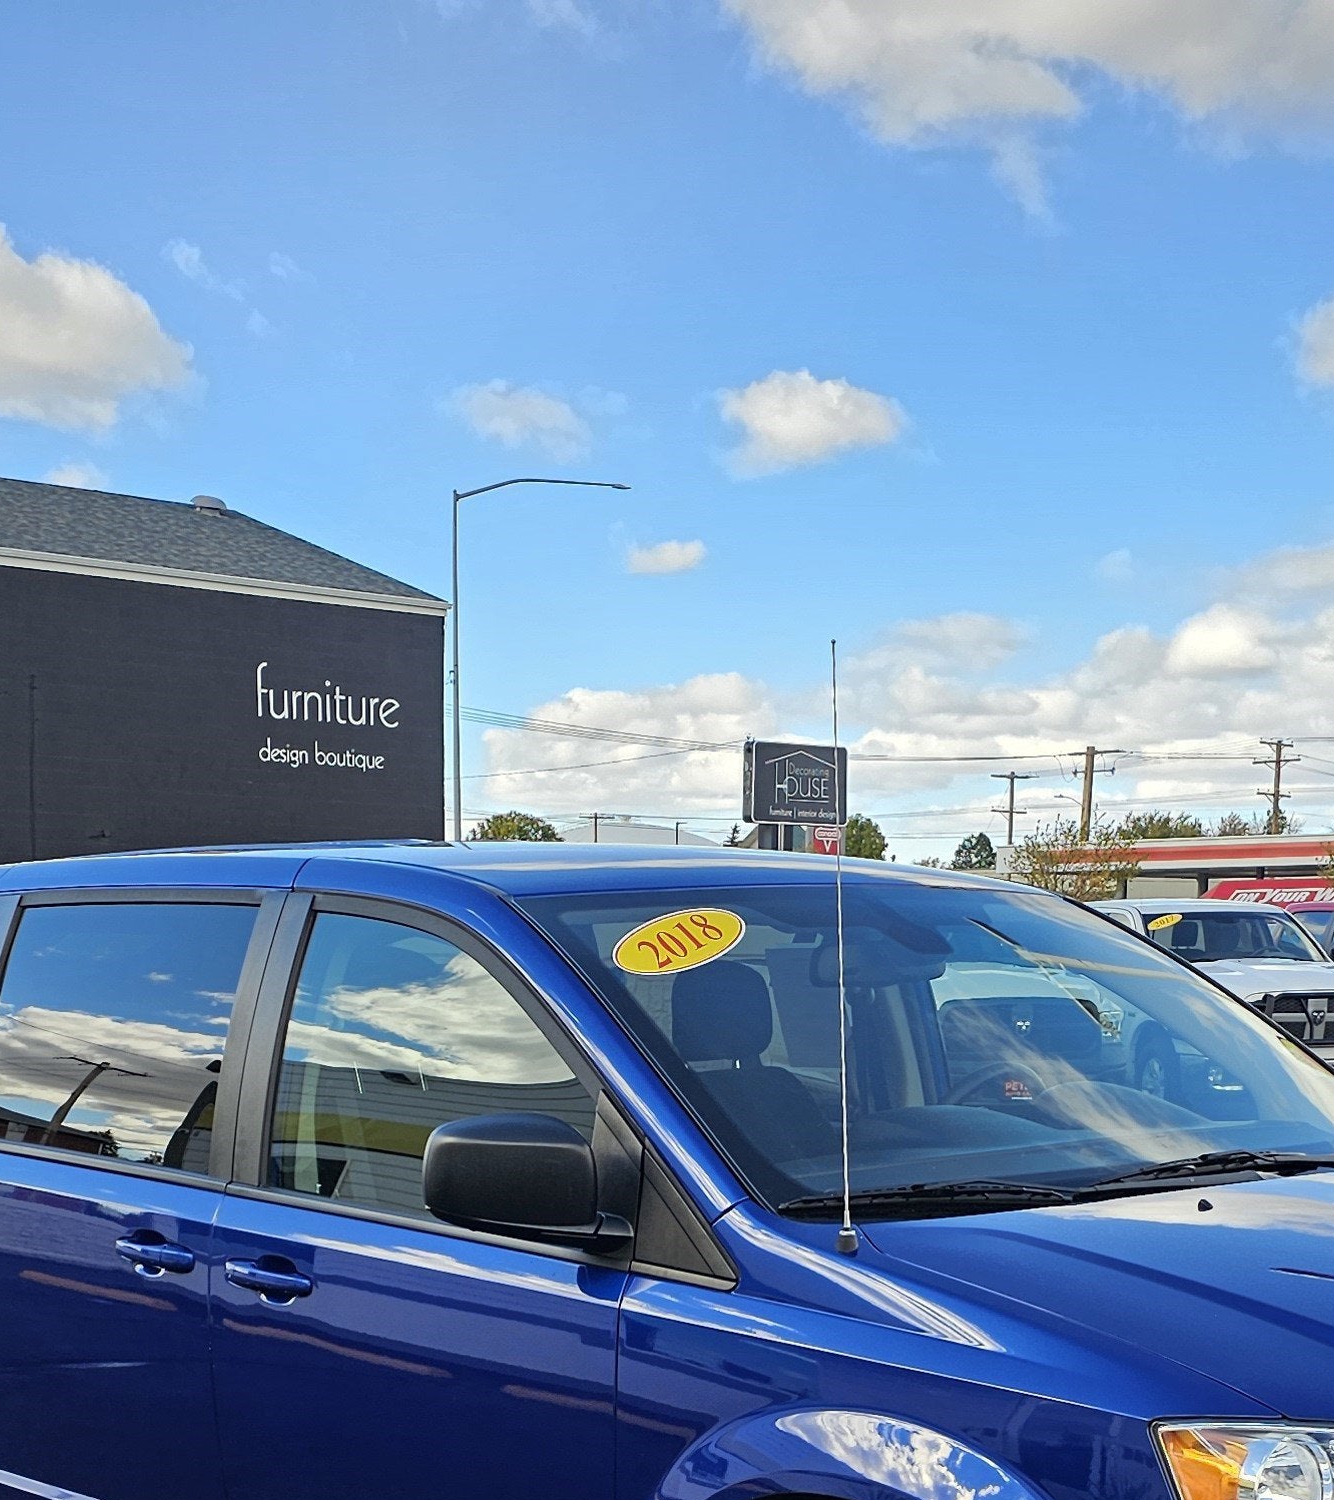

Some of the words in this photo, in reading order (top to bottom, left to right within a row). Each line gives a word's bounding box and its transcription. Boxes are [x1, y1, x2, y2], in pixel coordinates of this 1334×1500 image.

[256, 661, 401, 729] furniture
[258, 736, 309, 769] design
[314, 740, 385, 773] boutique
[788, 762, 830, 777] Decorating
[768, 805, 793, 817] furniture
[797, 809, 817, 818] interior
[817, 807, 837, 820] design
[636, 914, 723, 969] 2018
